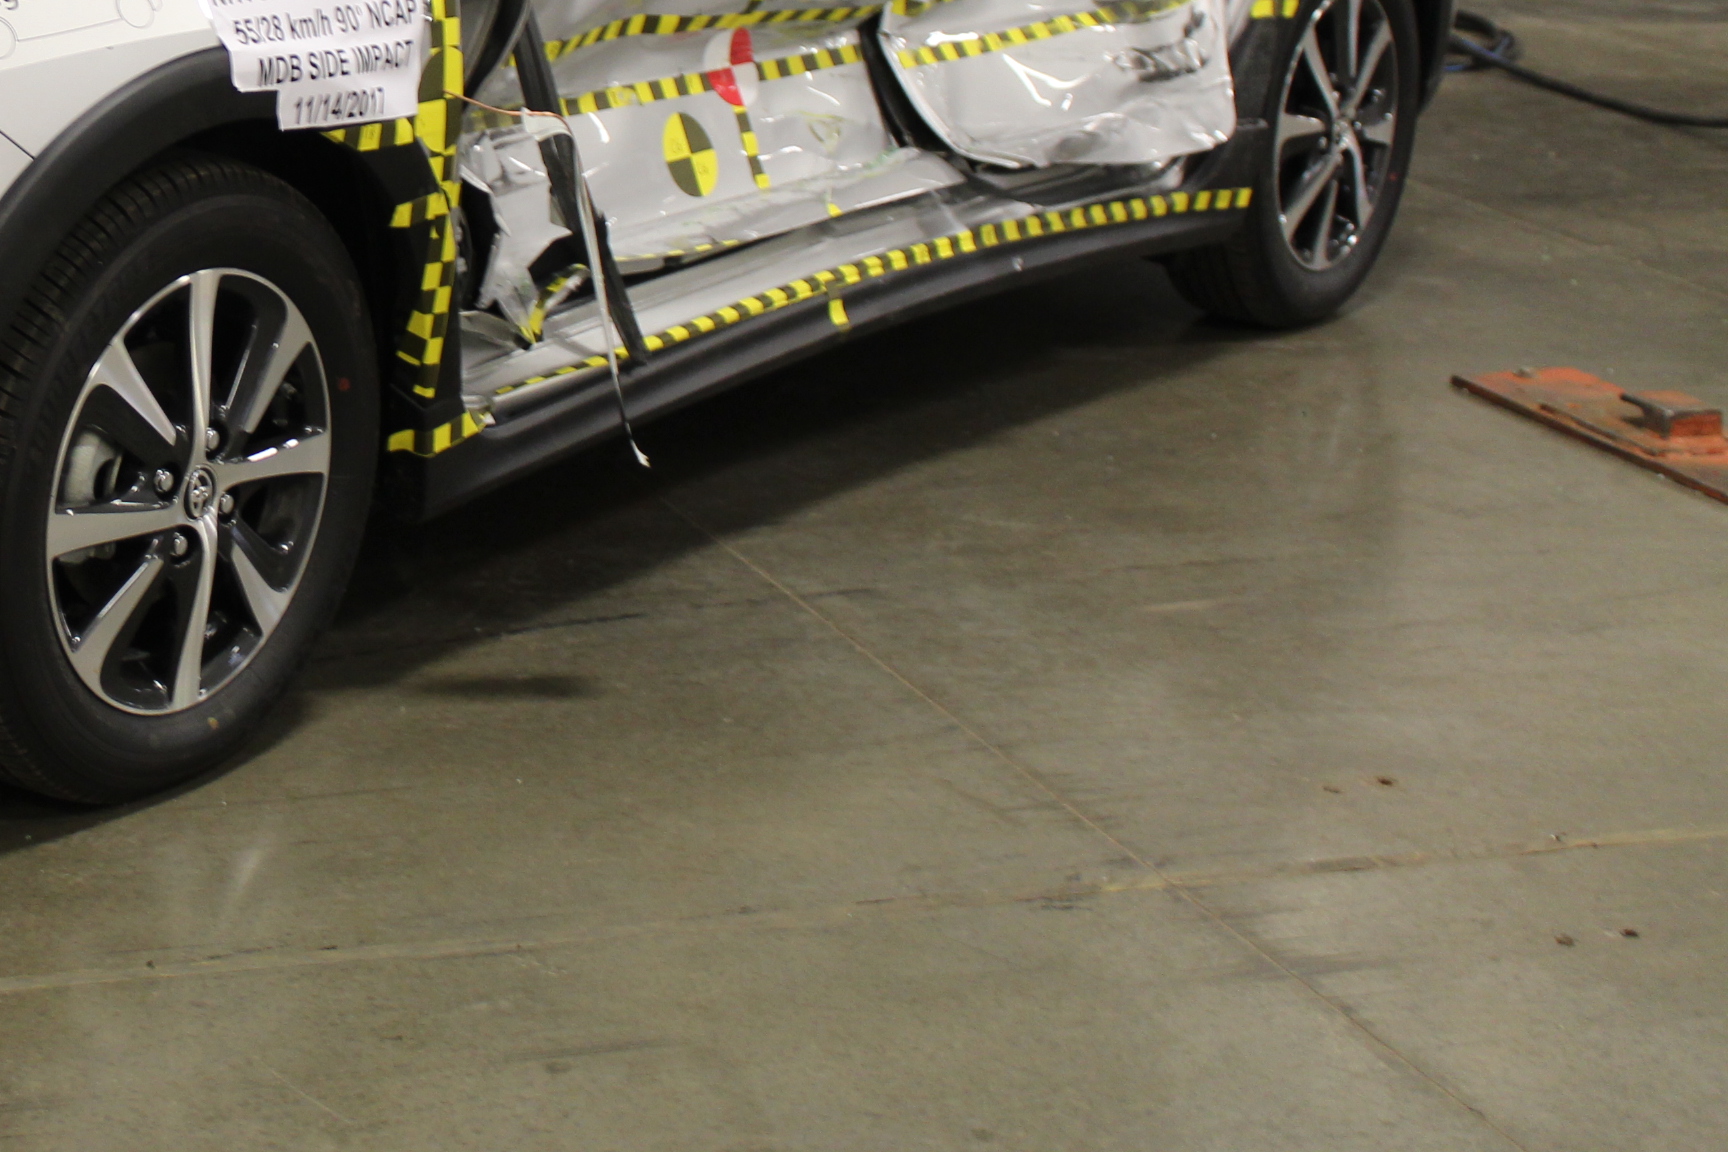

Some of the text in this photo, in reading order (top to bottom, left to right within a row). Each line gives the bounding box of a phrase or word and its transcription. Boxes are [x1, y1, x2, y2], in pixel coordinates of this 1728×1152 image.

[234, 14, 285, 45] 55/28
[289, 8, 334, 40] km/h
[258, 41, 414, 87] MDB SIDE IMPACT
[294, 88, 385, 125] 11/14/2017
